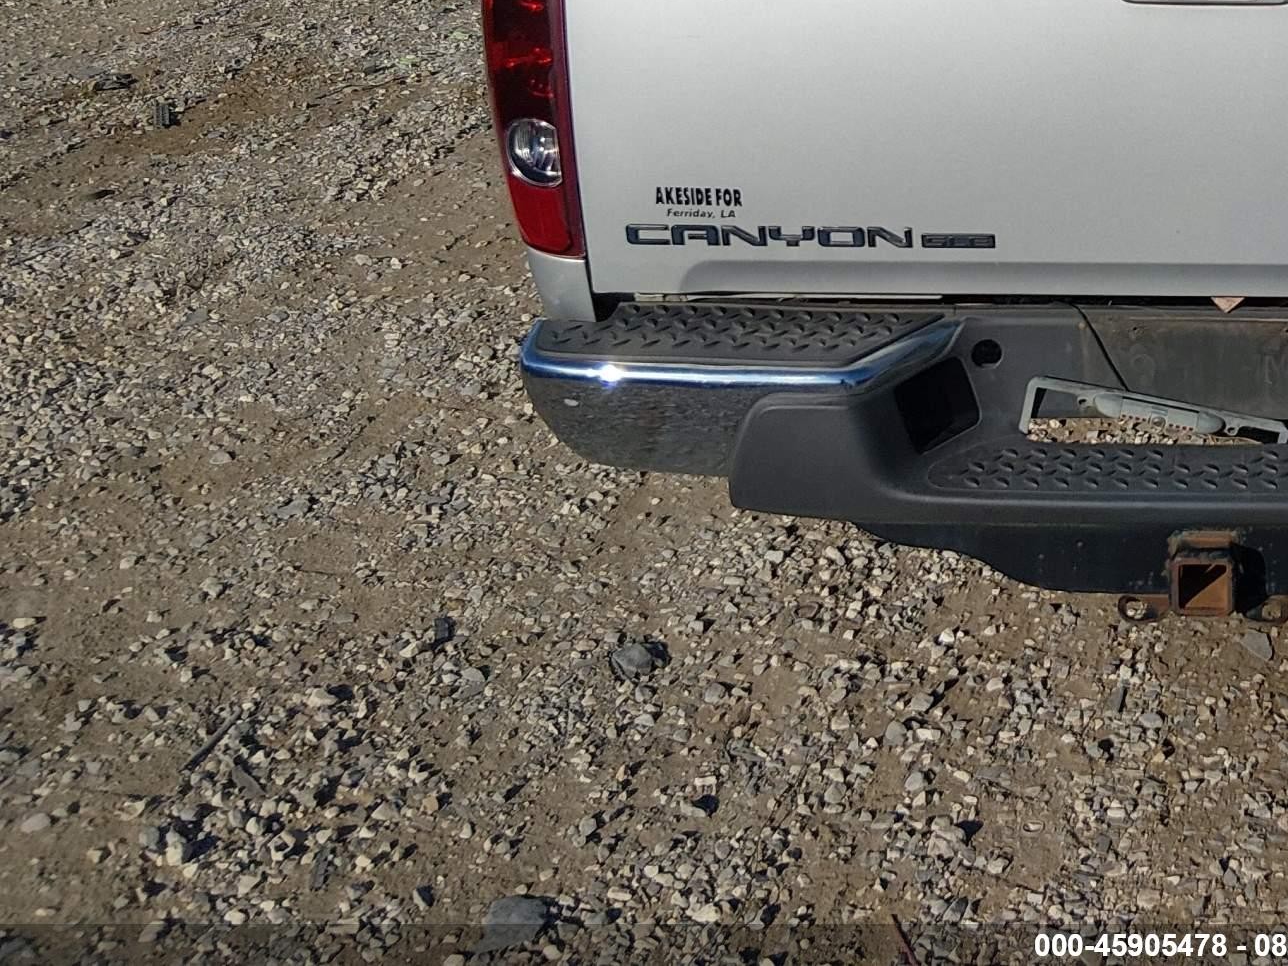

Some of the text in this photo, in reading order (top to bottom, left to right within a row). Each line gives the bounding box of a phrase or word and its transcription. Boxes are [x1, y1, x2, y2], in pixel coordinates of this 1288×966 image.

[656, 186, 743, 207] AKESIDE FOR
[667, 208, 736, 219] Ferriday, LA
[625, 223, 912, 249] CANYON
